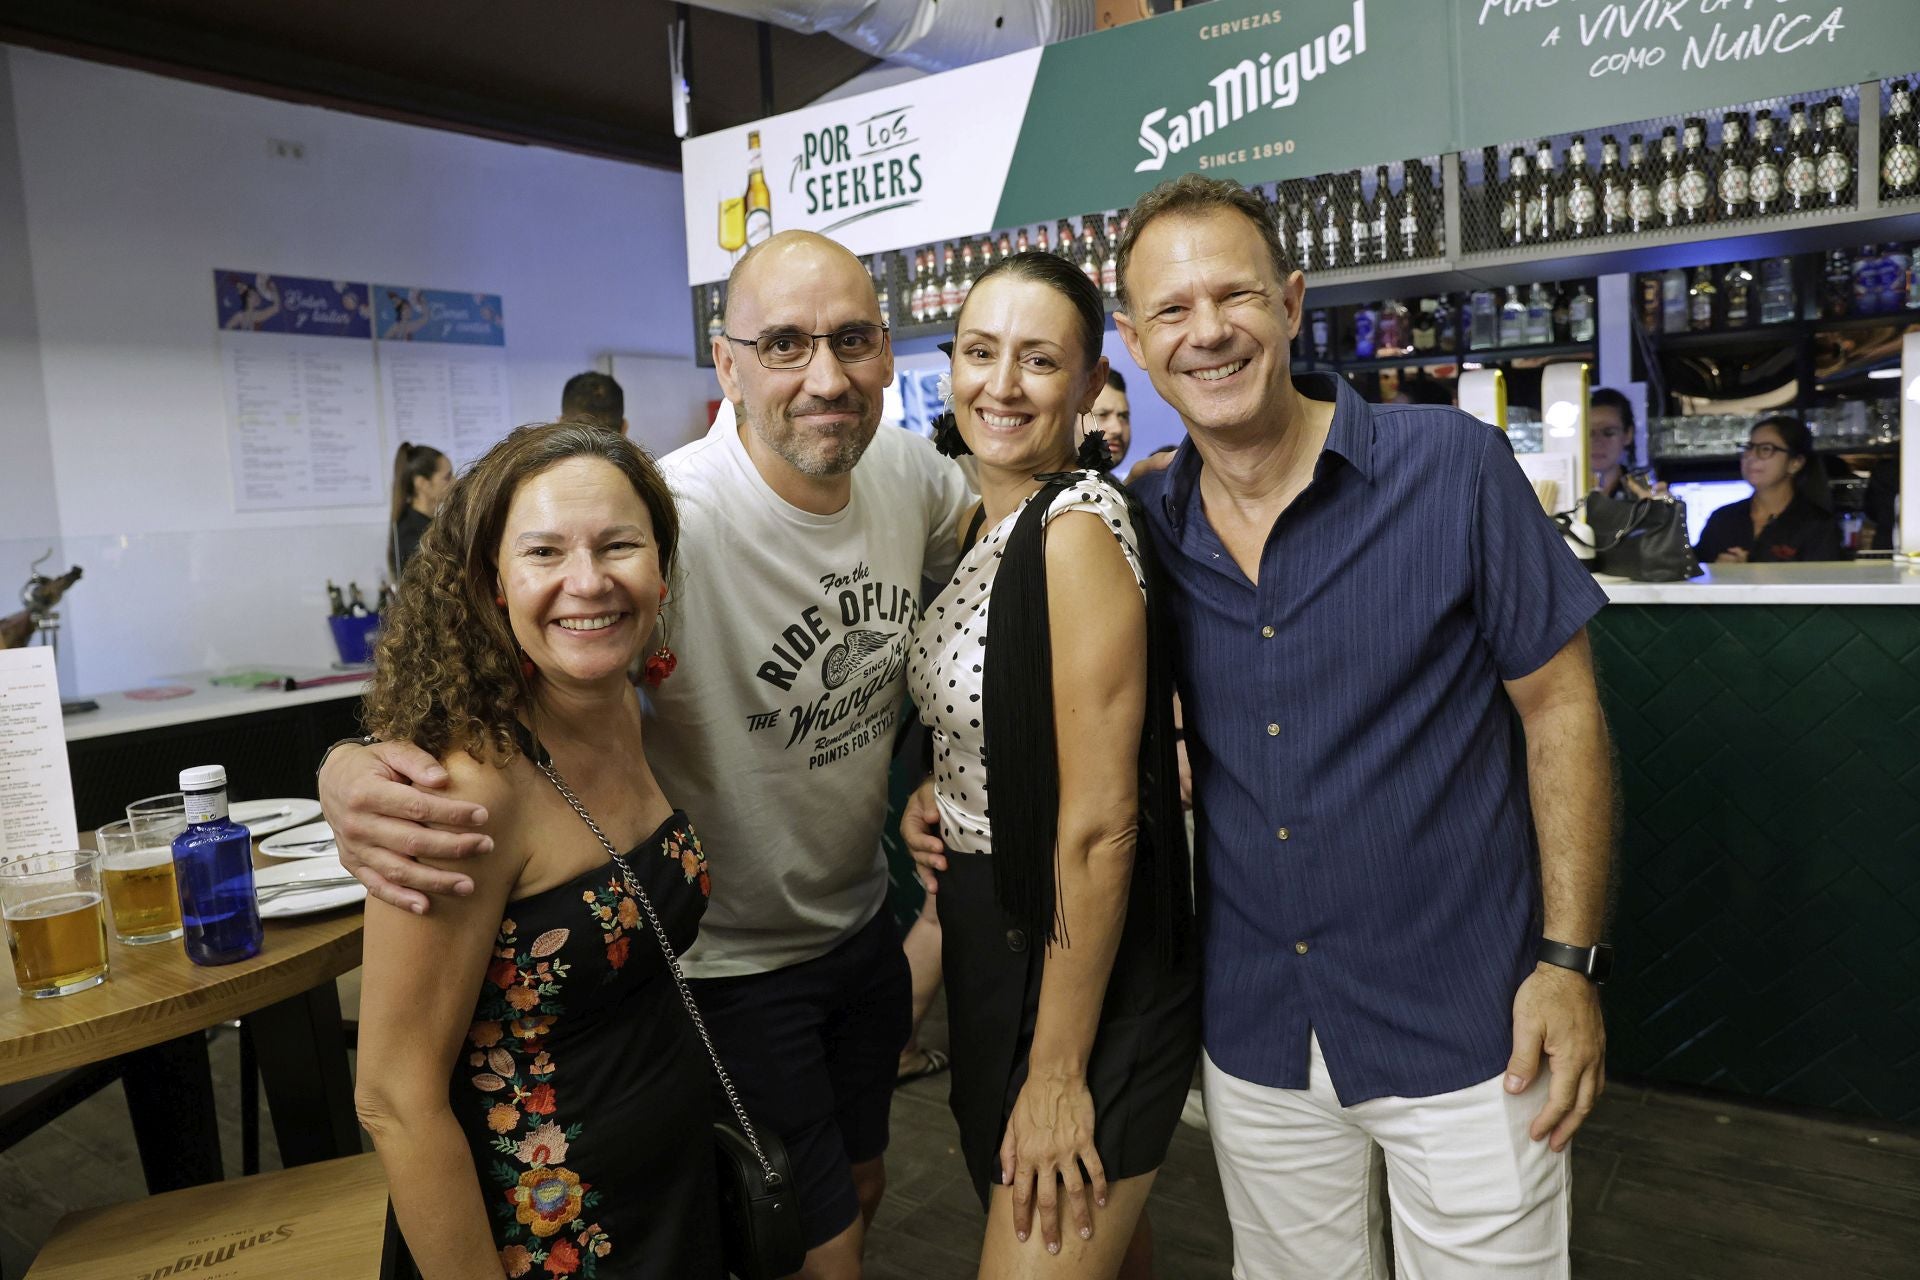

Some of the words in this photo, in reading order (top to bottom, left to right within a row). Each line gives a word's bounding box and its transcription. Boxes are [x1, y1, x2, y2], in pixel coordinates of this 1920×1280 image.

[1200, 10, 1282, 40] CERVEZAS
[1541, 26, 1561, 47] A
[1589, 47, 1666, 77] COMO
[1682, 7, 1845, 71] NUNCA
[803, 124, 852, 171] POR
[1199, 149, 1247, 169] SINCE
[1252, 140, 1295, 160] 1890
[806, 154, 923, 215] SEEKERS
[819, 573, 851, 595] For
[852, 561, 870, 583] the
[756, 605, 832, 692] RIDE
[863, 657, 888, 678] SINCE
[746, 708, 782, 732] THE
[784, 643, 908, 750] Wrangle
[809, 742, 850, 771] POINTS
[852, 730, 870, 752] FOR
